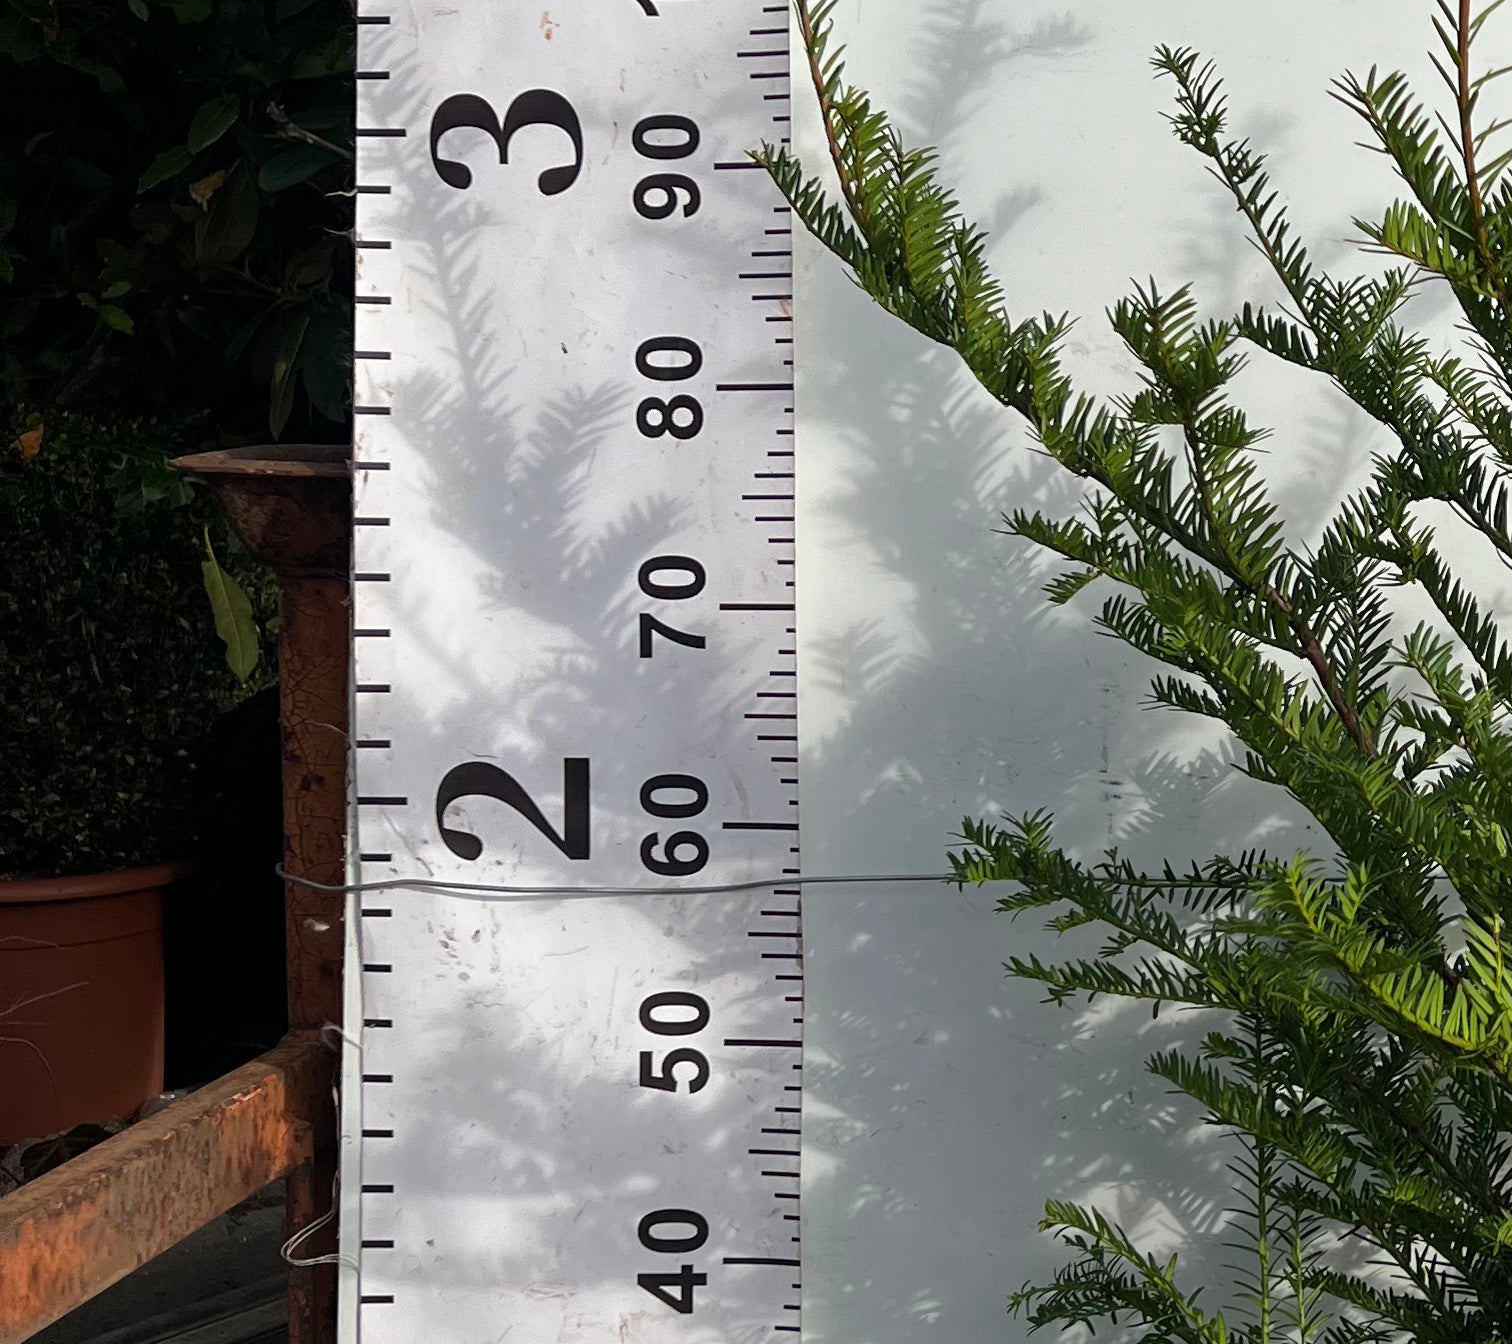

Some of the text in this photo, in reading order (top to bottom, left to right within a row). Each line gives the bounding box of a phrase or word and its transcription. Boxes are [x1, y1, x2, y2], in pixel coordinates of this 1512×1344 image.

[429, 88, 584, 197] 3
[631, 114, 701, 221] 90
[634, 336, 704, 441] 80
[637, 555, 707, 659] 70
[435, 757, 591, 862] 2
[639, 773, 710, 877] 60
[638, 991, 711, 1094] 50
[636, 1208, 710, 1315] 40
